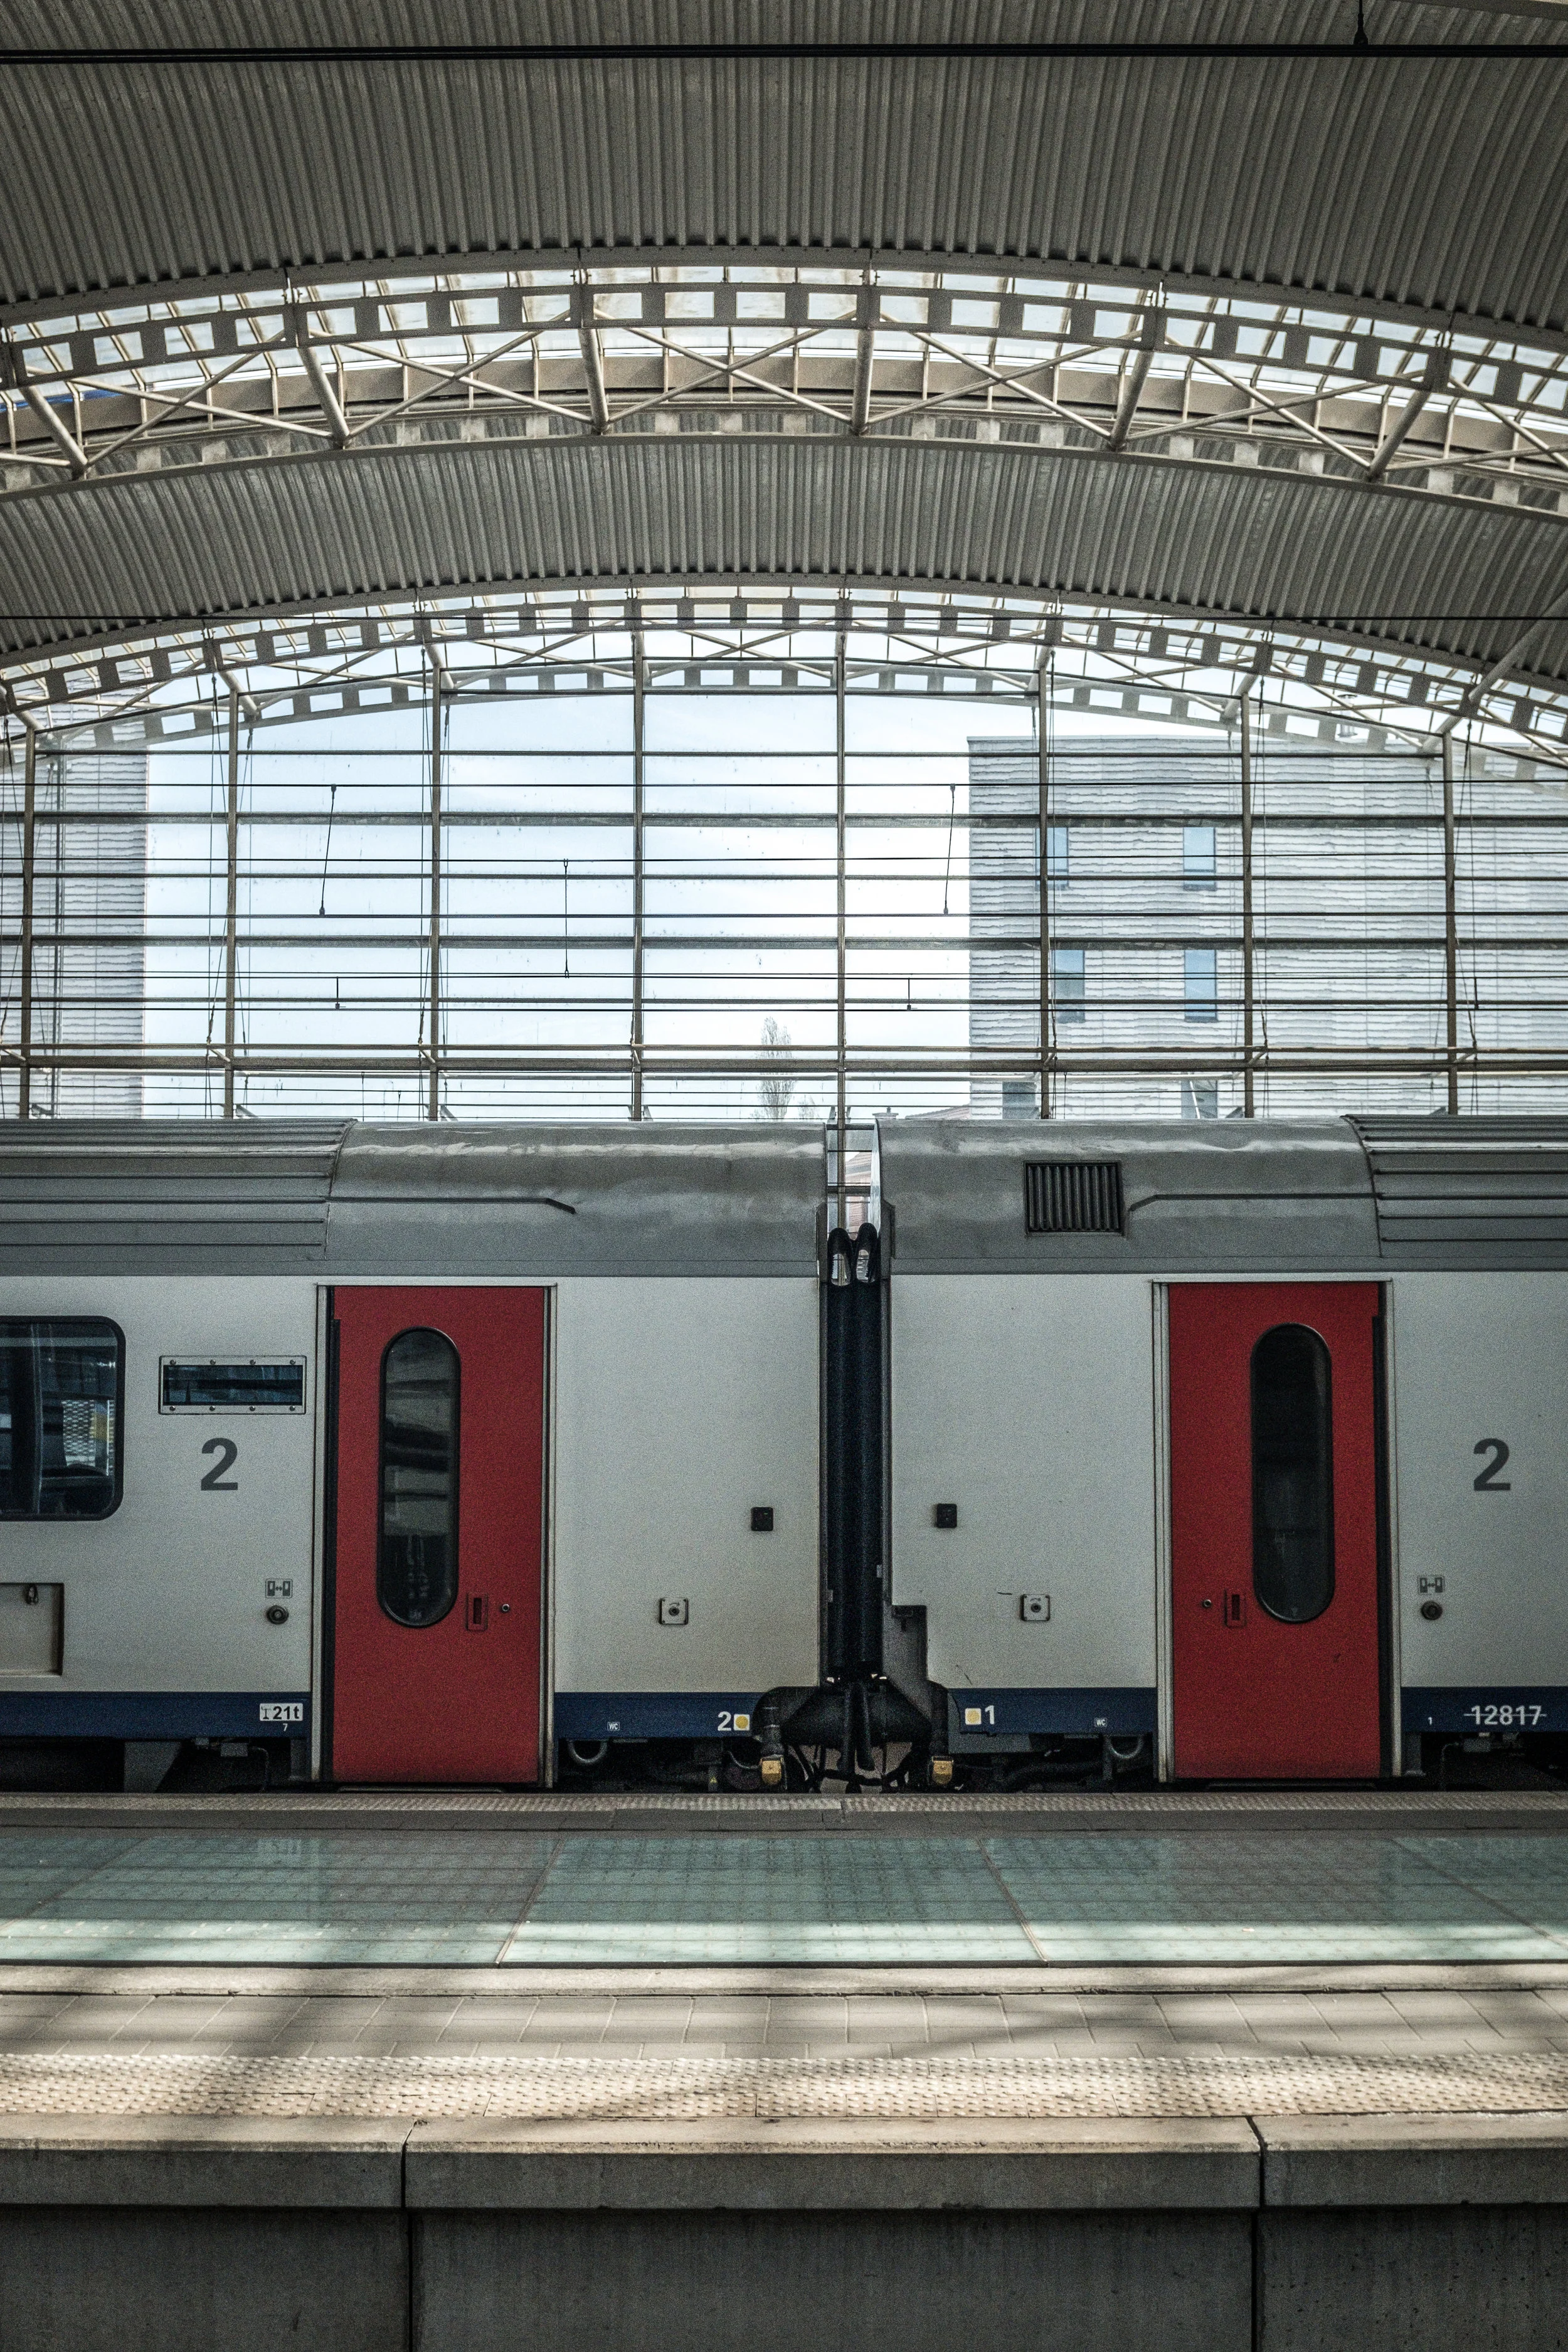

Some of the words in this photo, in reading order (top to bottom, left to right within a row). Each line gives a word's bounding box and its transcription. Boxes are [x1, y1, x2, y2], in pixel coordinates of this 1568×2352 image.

[201, 1438, 238, 1491] 2
[1473, 1438, 1511, 1491] 2
[273, 1706, 300, 1719] 21t
[717, 1711, 732, 1731] 2
[985, 1705, 995, 1725] 1
[1471, 1705, 1542, 1725] 12817
[283, 1723, 288, 1732] 7
